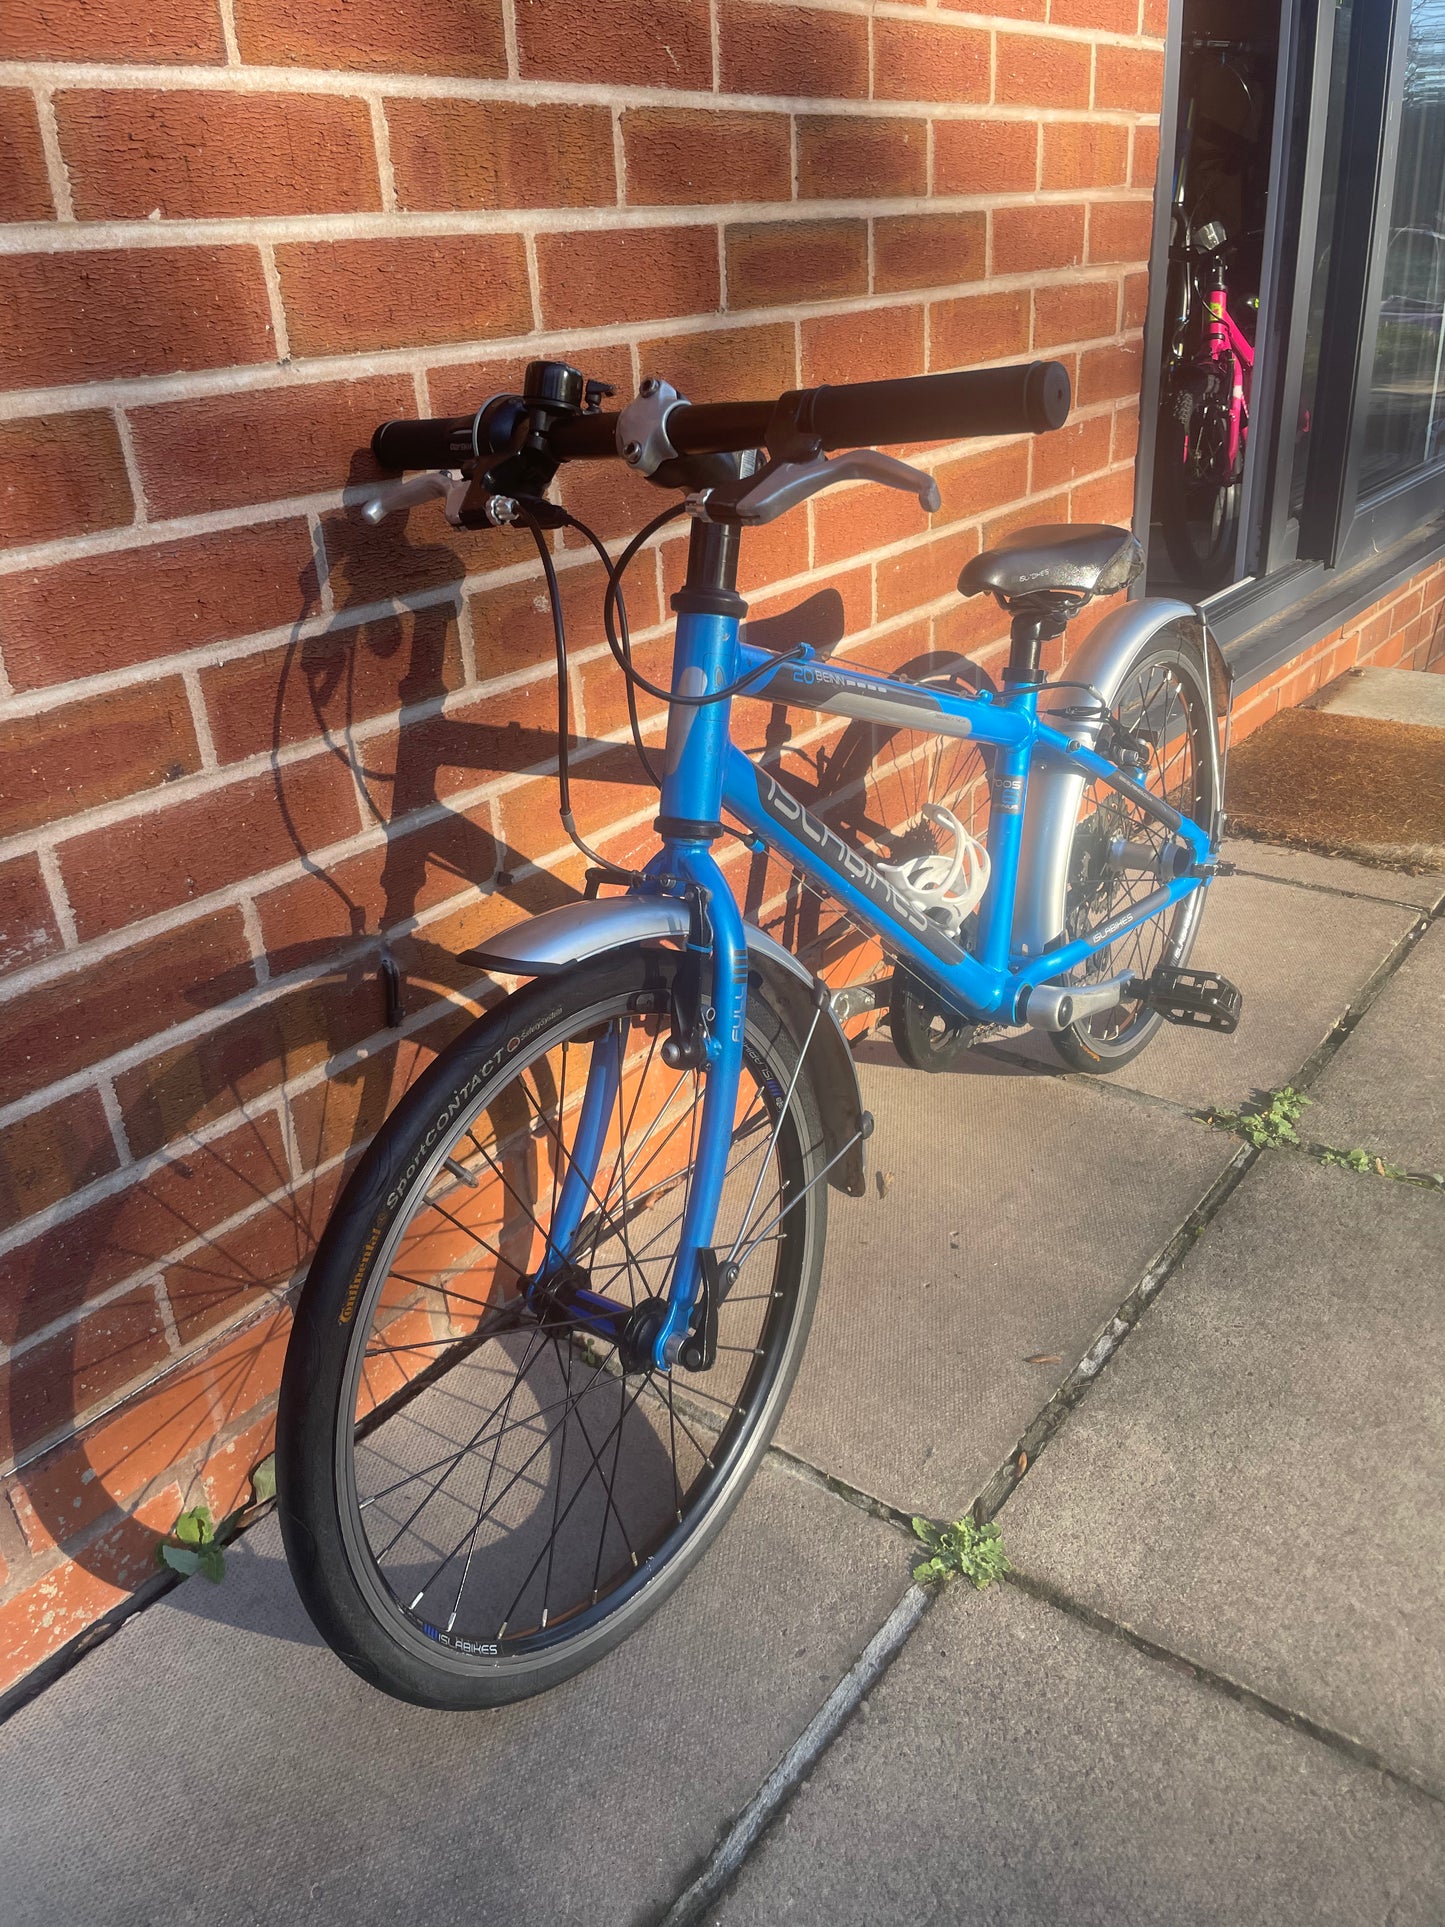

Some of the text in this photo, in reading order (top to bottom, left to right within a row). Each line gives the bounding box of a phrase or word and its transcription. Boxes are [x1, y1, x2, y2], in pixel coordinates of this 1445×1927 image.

[793, 665, 815, 685] 20
[1093, 912, 1134, 944] ISLABIKES
[731, 985, 745, 1043] FULL
[338, 1227, 382, 1324] Continental
[438, 1633, 498, 1656] ISLABIKES
